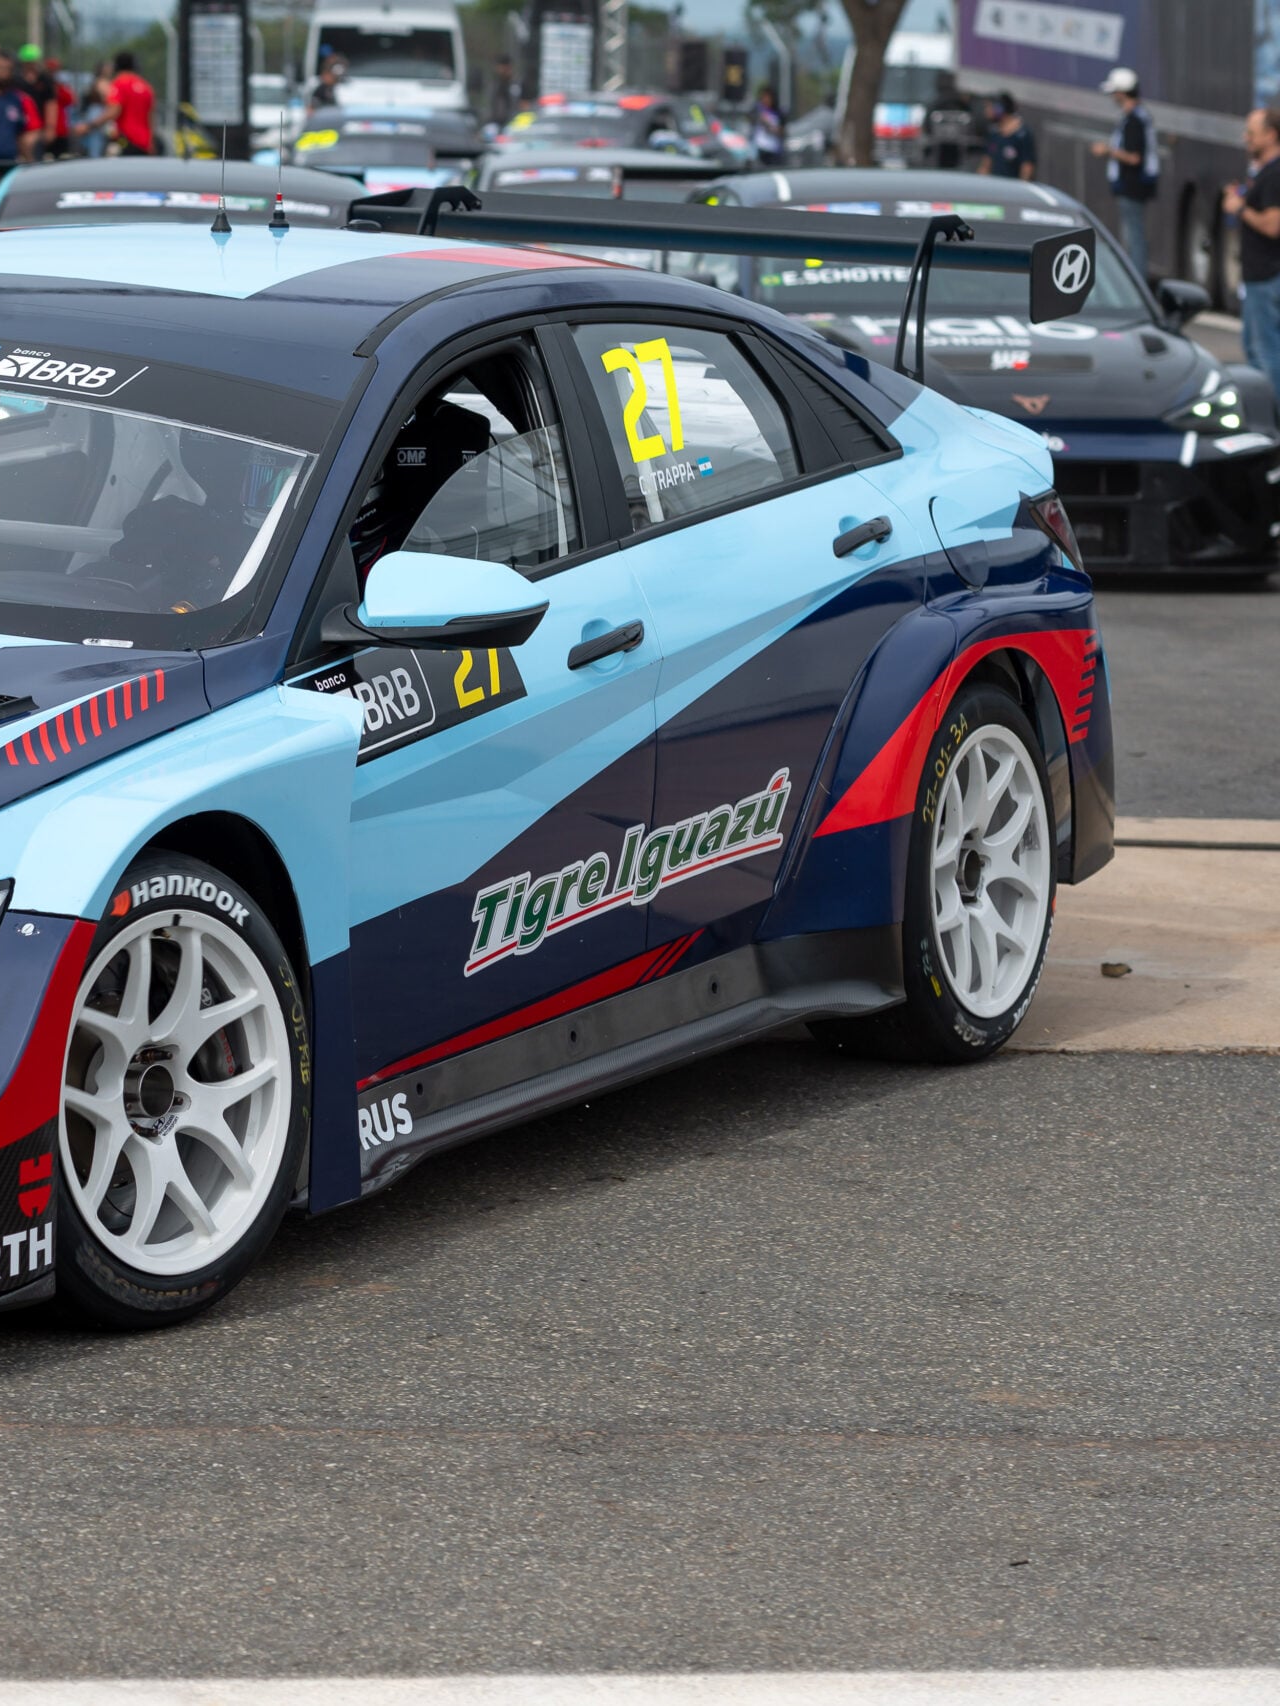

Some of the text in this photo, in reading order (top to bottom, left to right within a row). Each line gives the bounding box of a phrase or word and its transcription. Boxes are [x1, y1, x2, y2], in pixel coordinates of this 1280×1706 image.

[12, 347, 52, 358] banco
[28, 358, 118, 389] BRB
[600, 337, 686, 464] 27
[396, 448, 427, 465] OMP
[650, 461, 696, 492] TRAPPA
[314, 672, 347, 692] banco
[353, 667, 421, 732] BRB
[473, 775, 787, 949] Tigre Iguazú
